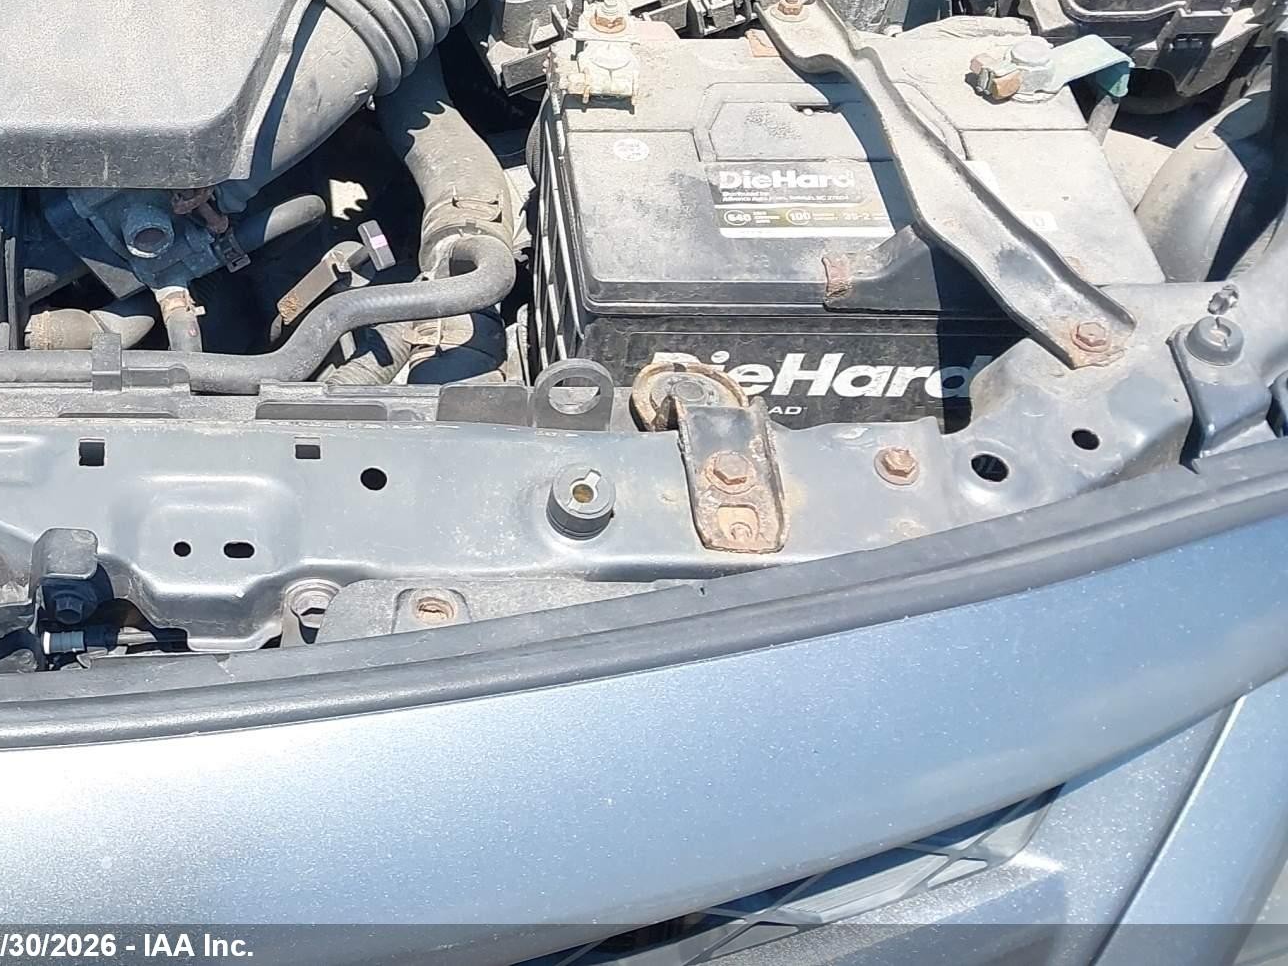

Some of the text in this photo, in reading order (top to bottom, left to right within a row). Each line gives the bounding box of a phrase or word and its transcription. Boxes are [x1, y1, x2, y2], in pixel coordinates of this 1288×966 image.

[719, 170, 854, 188] DieHard
[790, 212, 811, 221] 100
[652, 350, 994, 398] eHard
